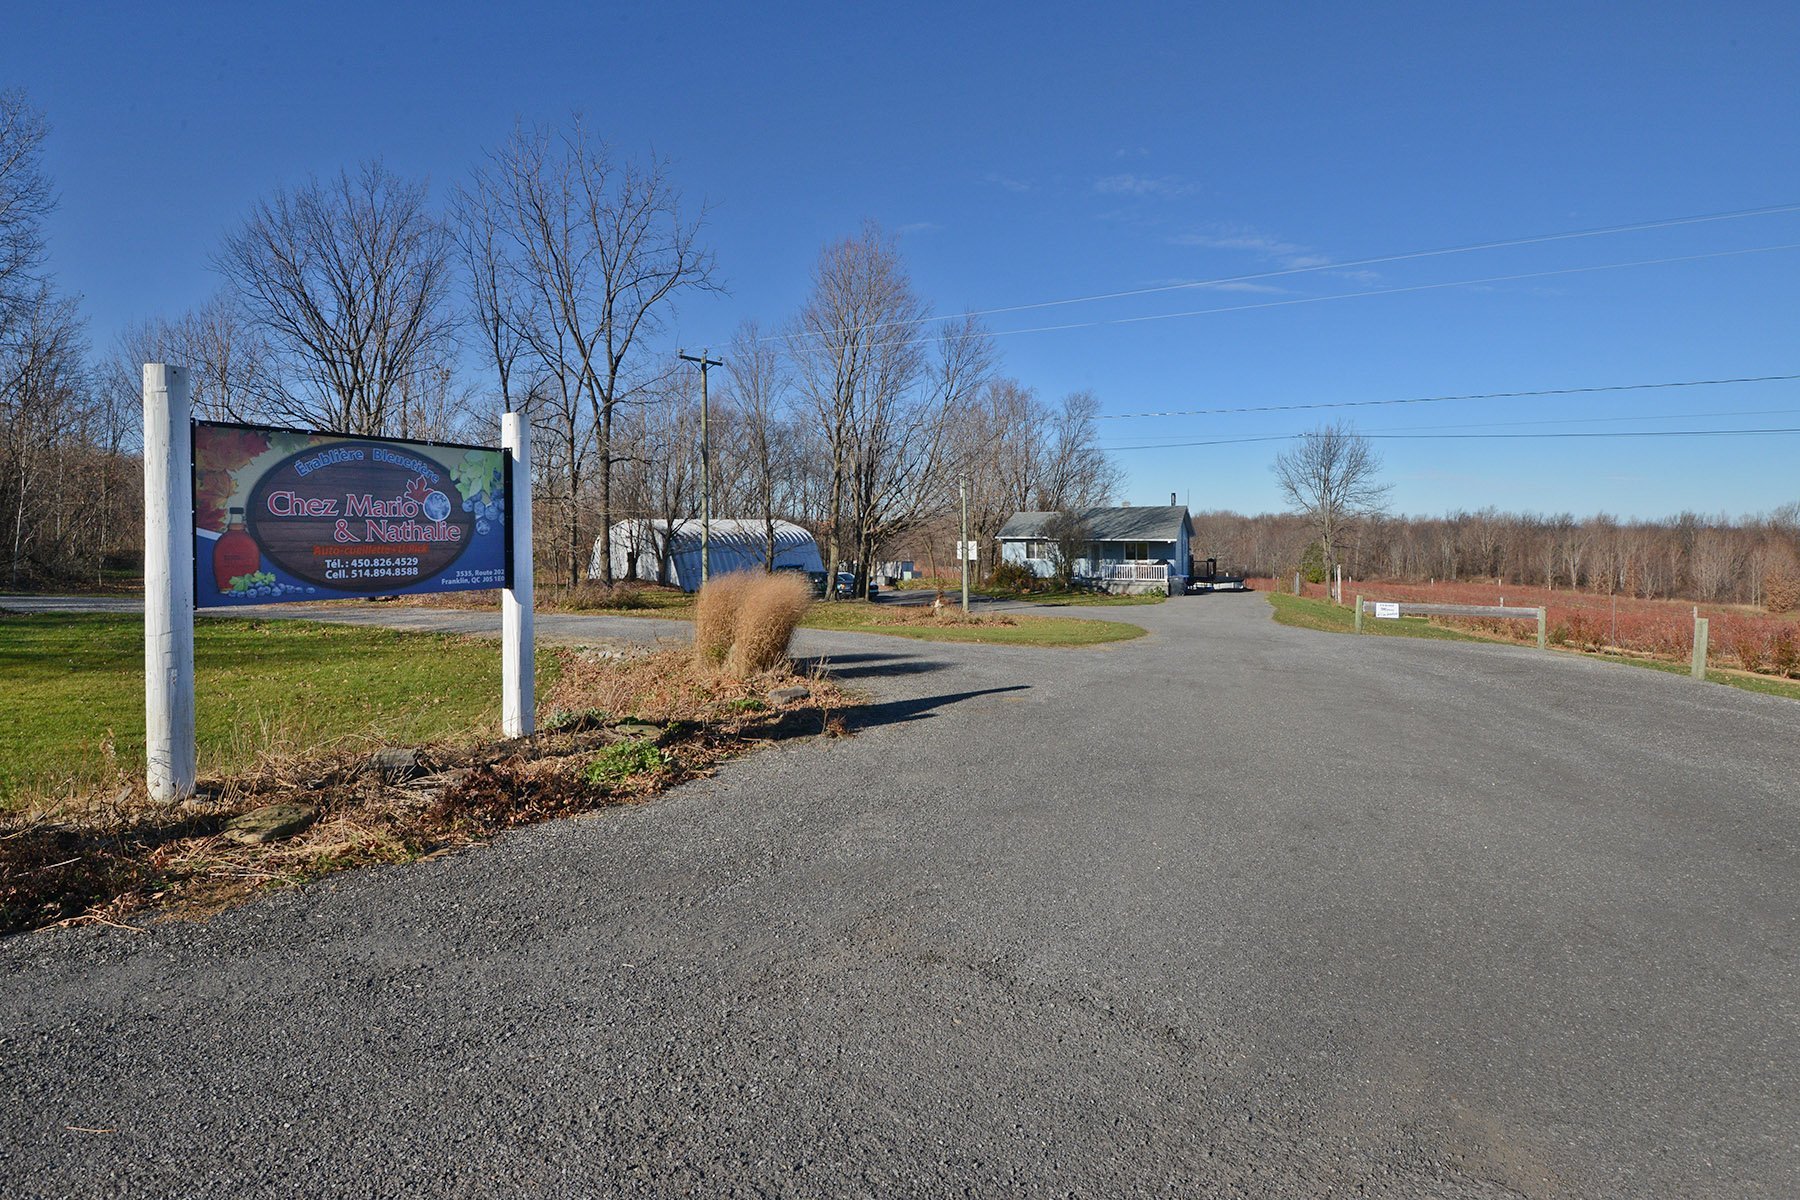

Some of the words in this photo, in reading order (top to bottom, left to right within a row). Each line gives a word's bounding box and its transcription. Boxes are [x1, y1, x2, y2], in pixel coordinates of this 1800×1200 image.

[294, 448, 364, 477] Érablière
[372, 447, 440, 484] Bleuetière
[267, 490, 339, 517] Chez
[344, 493, 419, 518] Mario
[333, 518, 361, 543] &
[365, 519, 461, 543] Nathalie
[351, 557, 419, 568] 450.826.4529
[325, 569, 349, 579] Cell.
[351, 567, 419, 578] 514.894.8588
[475, 569, 493, 577] Route
[494, 568, 505, 576] 202
[471, 576, 481, 584] QC
